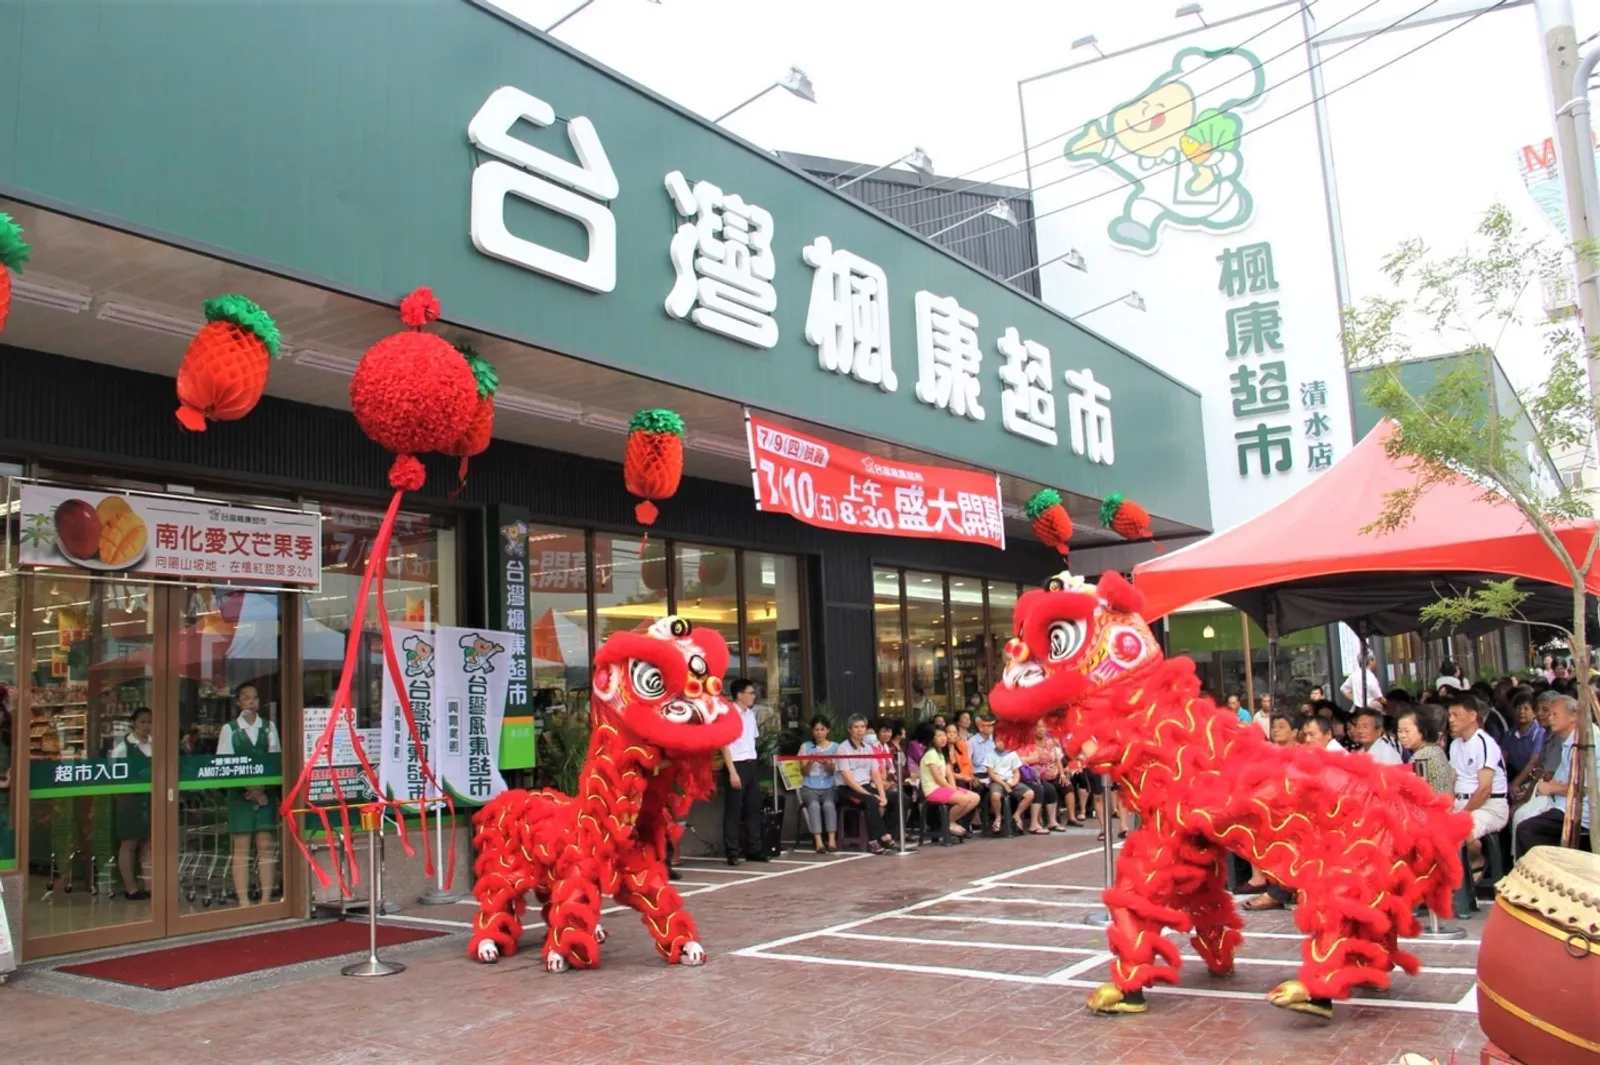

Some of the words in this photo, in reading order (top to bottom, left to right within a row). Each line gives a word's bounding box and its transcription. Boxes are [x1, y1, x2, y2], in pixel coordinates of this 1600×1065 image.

[468, 84, 1115, 466] 台灣楓康超市
[1215, 241, 1293, 477] 楓康超市
[1299, 380, 1333, 473] 清水店
[839, 501, 895, 530] 8:30
[843, 475, 884, 507] 上午
[895, 485, 1002, 541] 盛大開幕
[155, 523, 314, 561] 南化愛文芒果季
[506, 560, 528, 706] 台灣楓康超市
[54, 762, 129, 783] 超市入口
